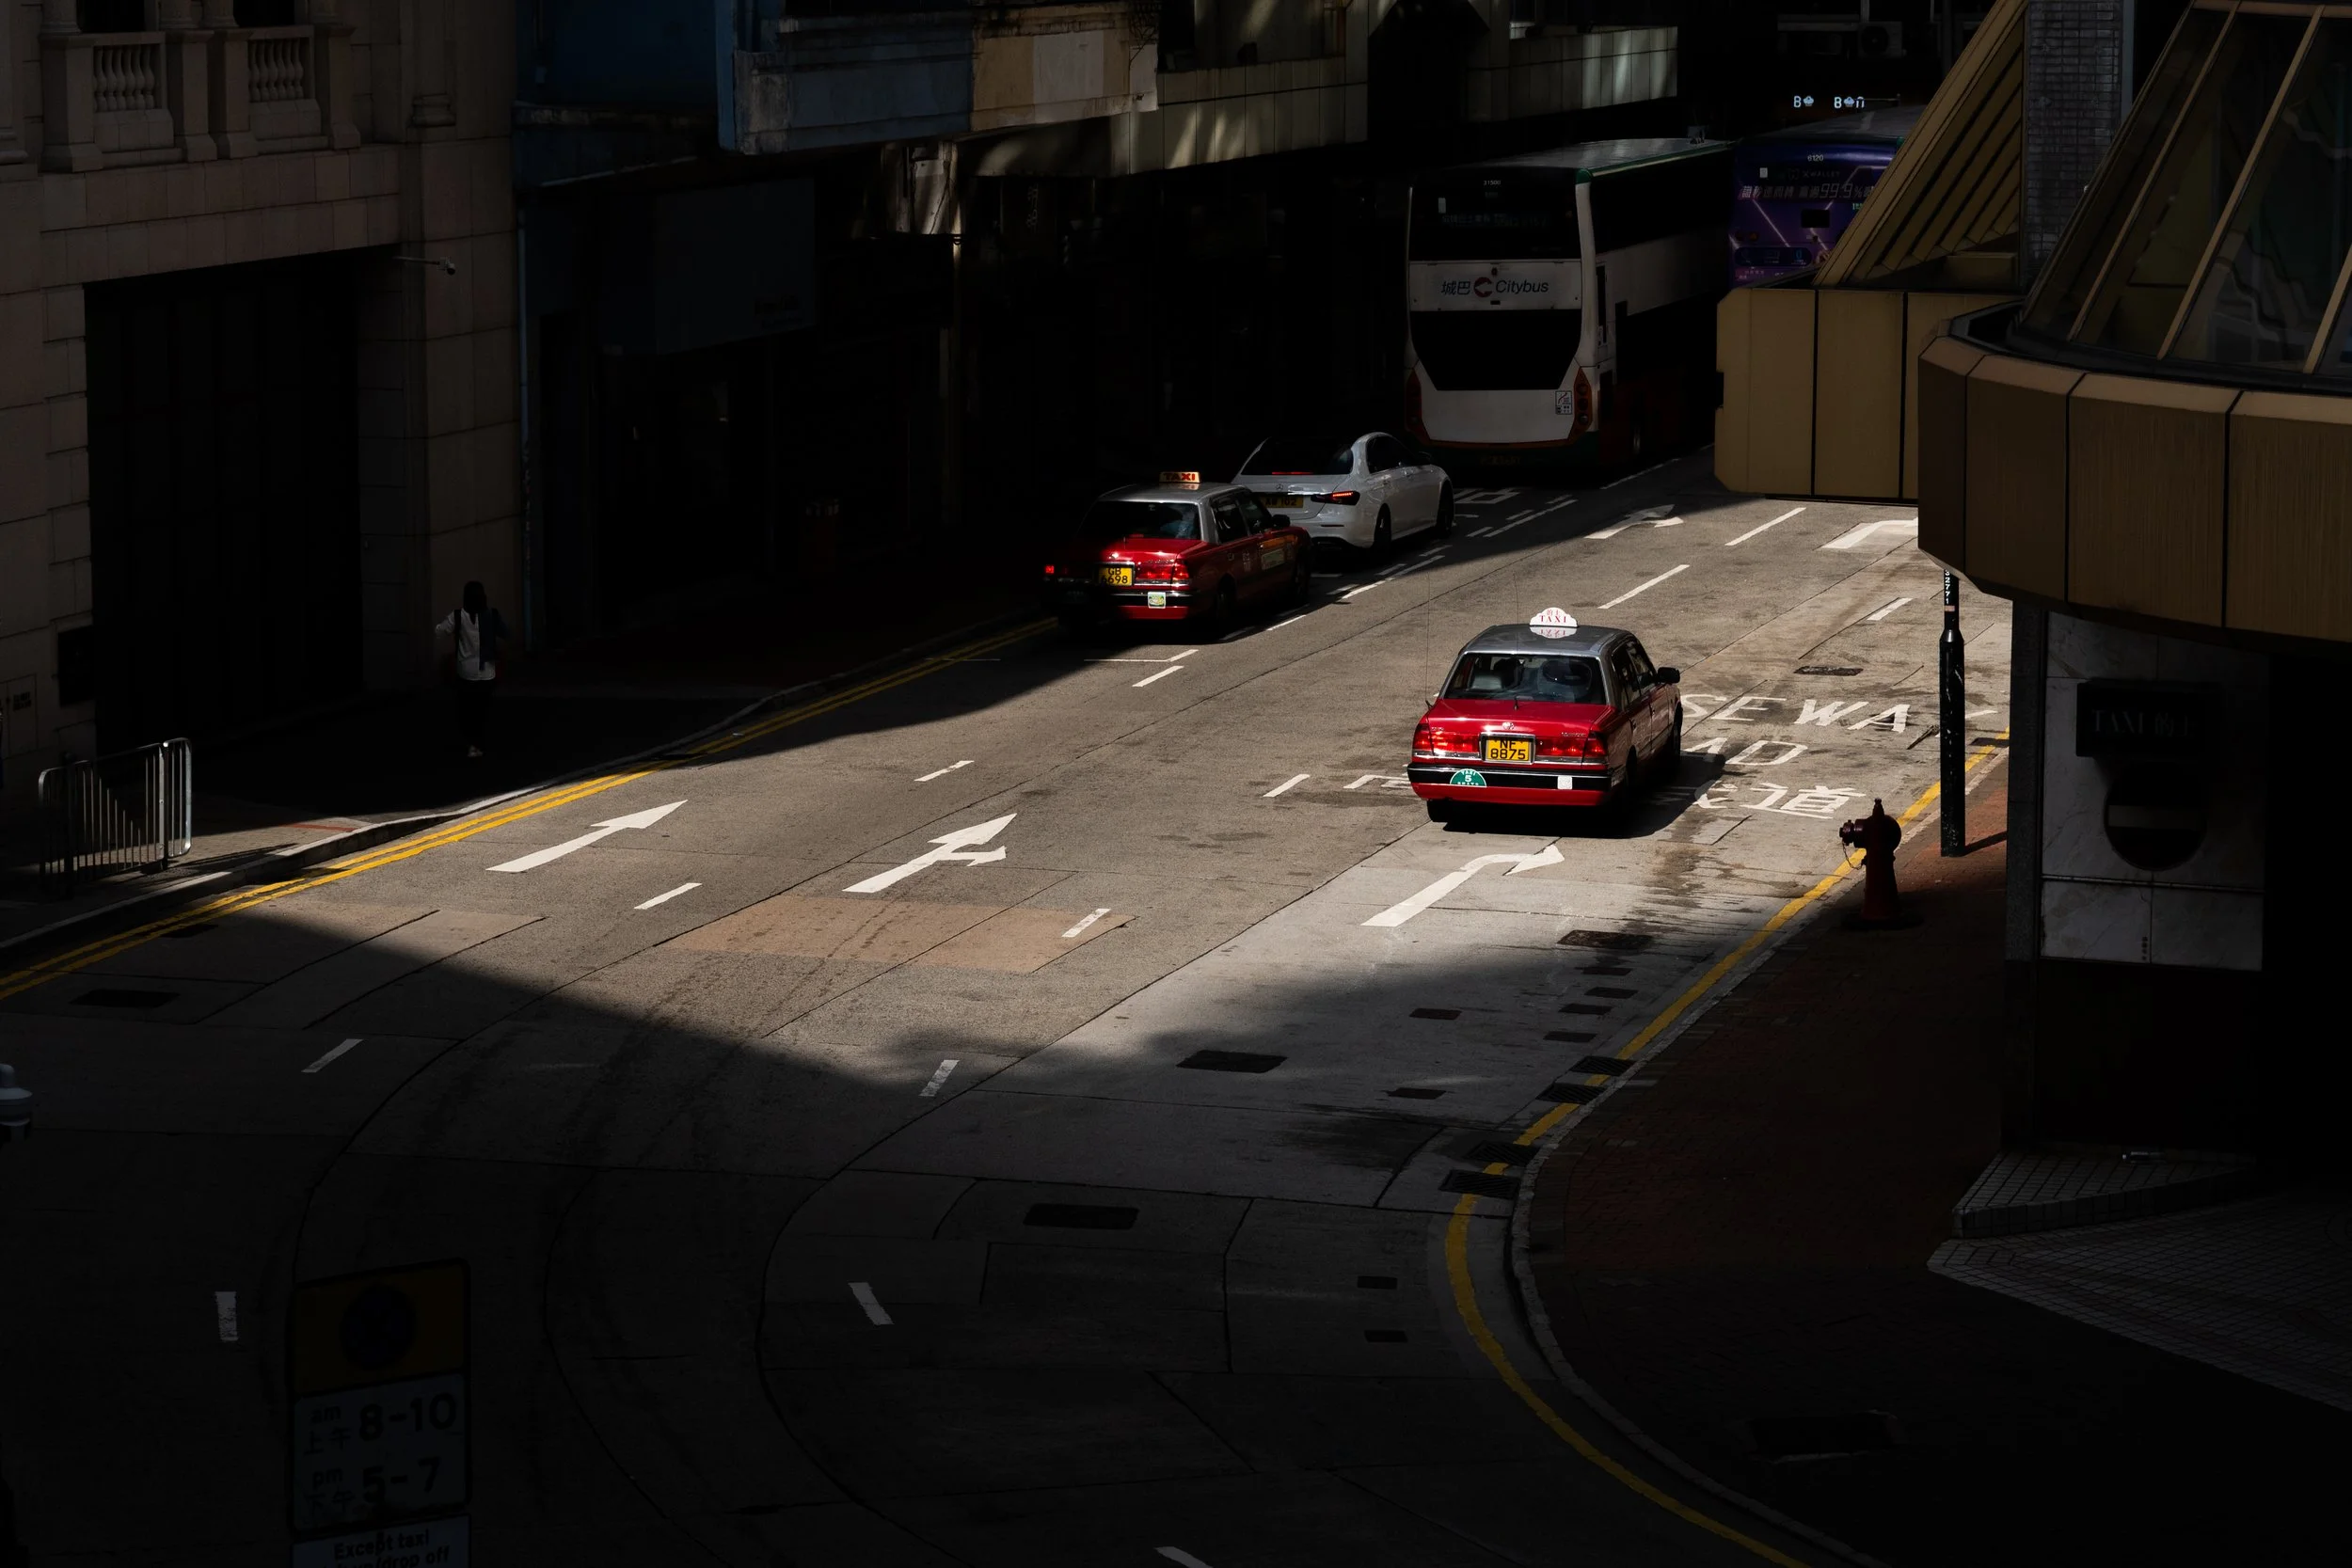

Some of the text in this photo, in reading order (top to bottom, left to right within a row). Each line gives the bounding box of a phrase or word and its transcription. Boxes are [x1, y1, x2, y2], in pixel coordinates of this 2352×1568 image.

[1440, 280, 1471, 295] 城巴
[1495, 279, 1549, 294] Citybus
[1163, 473, 1197, 482] TAXI
[1107, 567, 1121, 576] GB
[1101, 575, 1129, 584] 6698
[1538, 614, 1567, 624] TAXI
[1490, 748, 1526, 760] 8875
[1464, 774, 1472, 783] 5
[310, 1392, 457, 1442] am 8-10
[302, 1427, 352, 1456] 上午
[311, 1456, 441, 1504] pm 5-7
[333, 1528, 430, 1560] Except taxi
[425, 1544, 451, 1565] off
